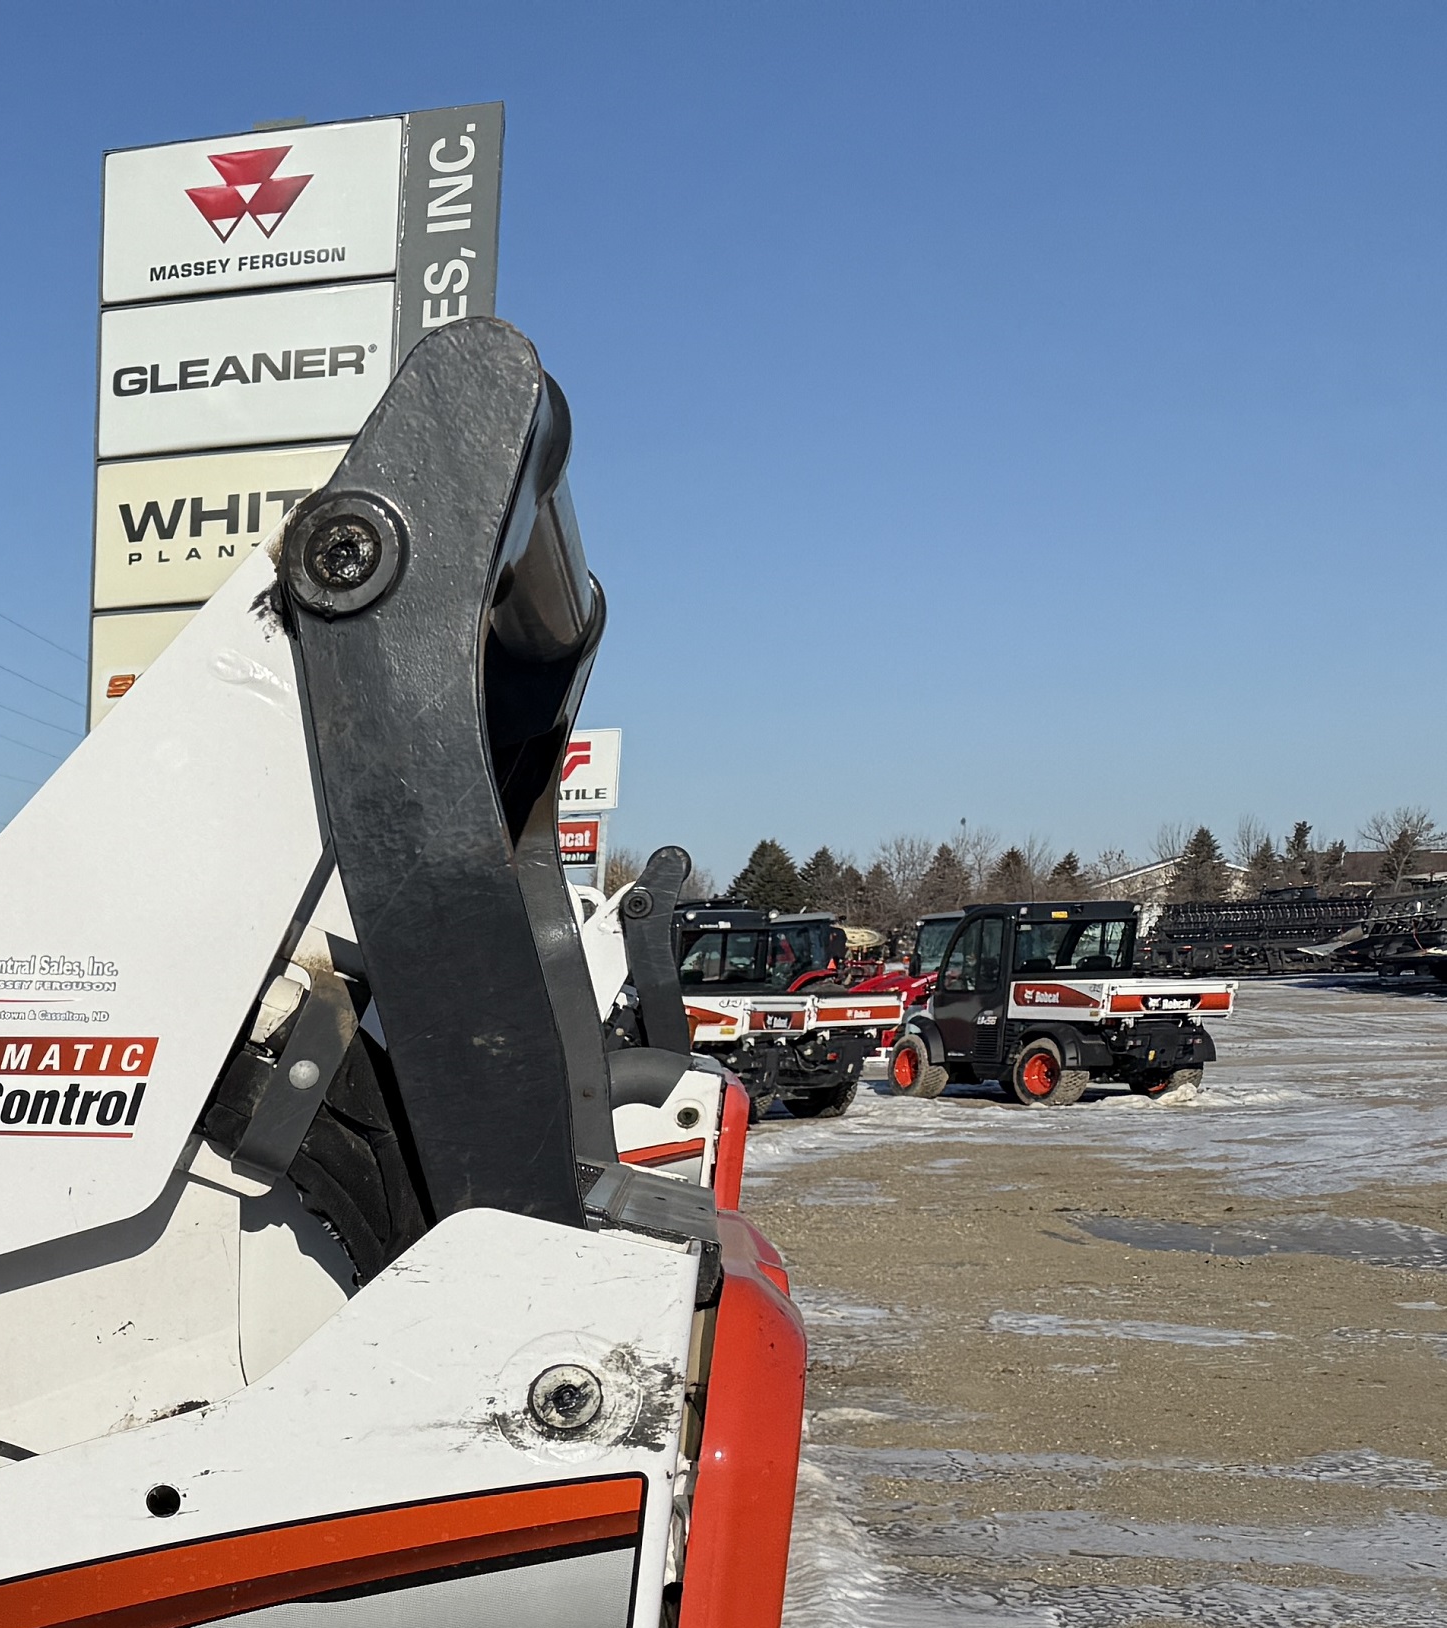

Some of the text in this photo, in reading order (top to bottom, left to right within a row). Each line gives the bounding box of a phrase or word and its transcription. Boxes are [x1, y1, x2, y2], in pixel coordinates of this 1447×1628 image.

[426, 123, 476, 233] INC.
[150, 246, 346, 282] MASSEY FERGUSON
[128, 541, 260, 566] PLAN
[39, 955, 85, 978] Sales,
[87, 956, 119, 977] Inc.
[35, 980, 117, 992] FERGUSON
[28, 1010, 37, 1021] &
[39, 1010, 89, 1023] Casselton,
[92, 1011, 110, 1022] ND
